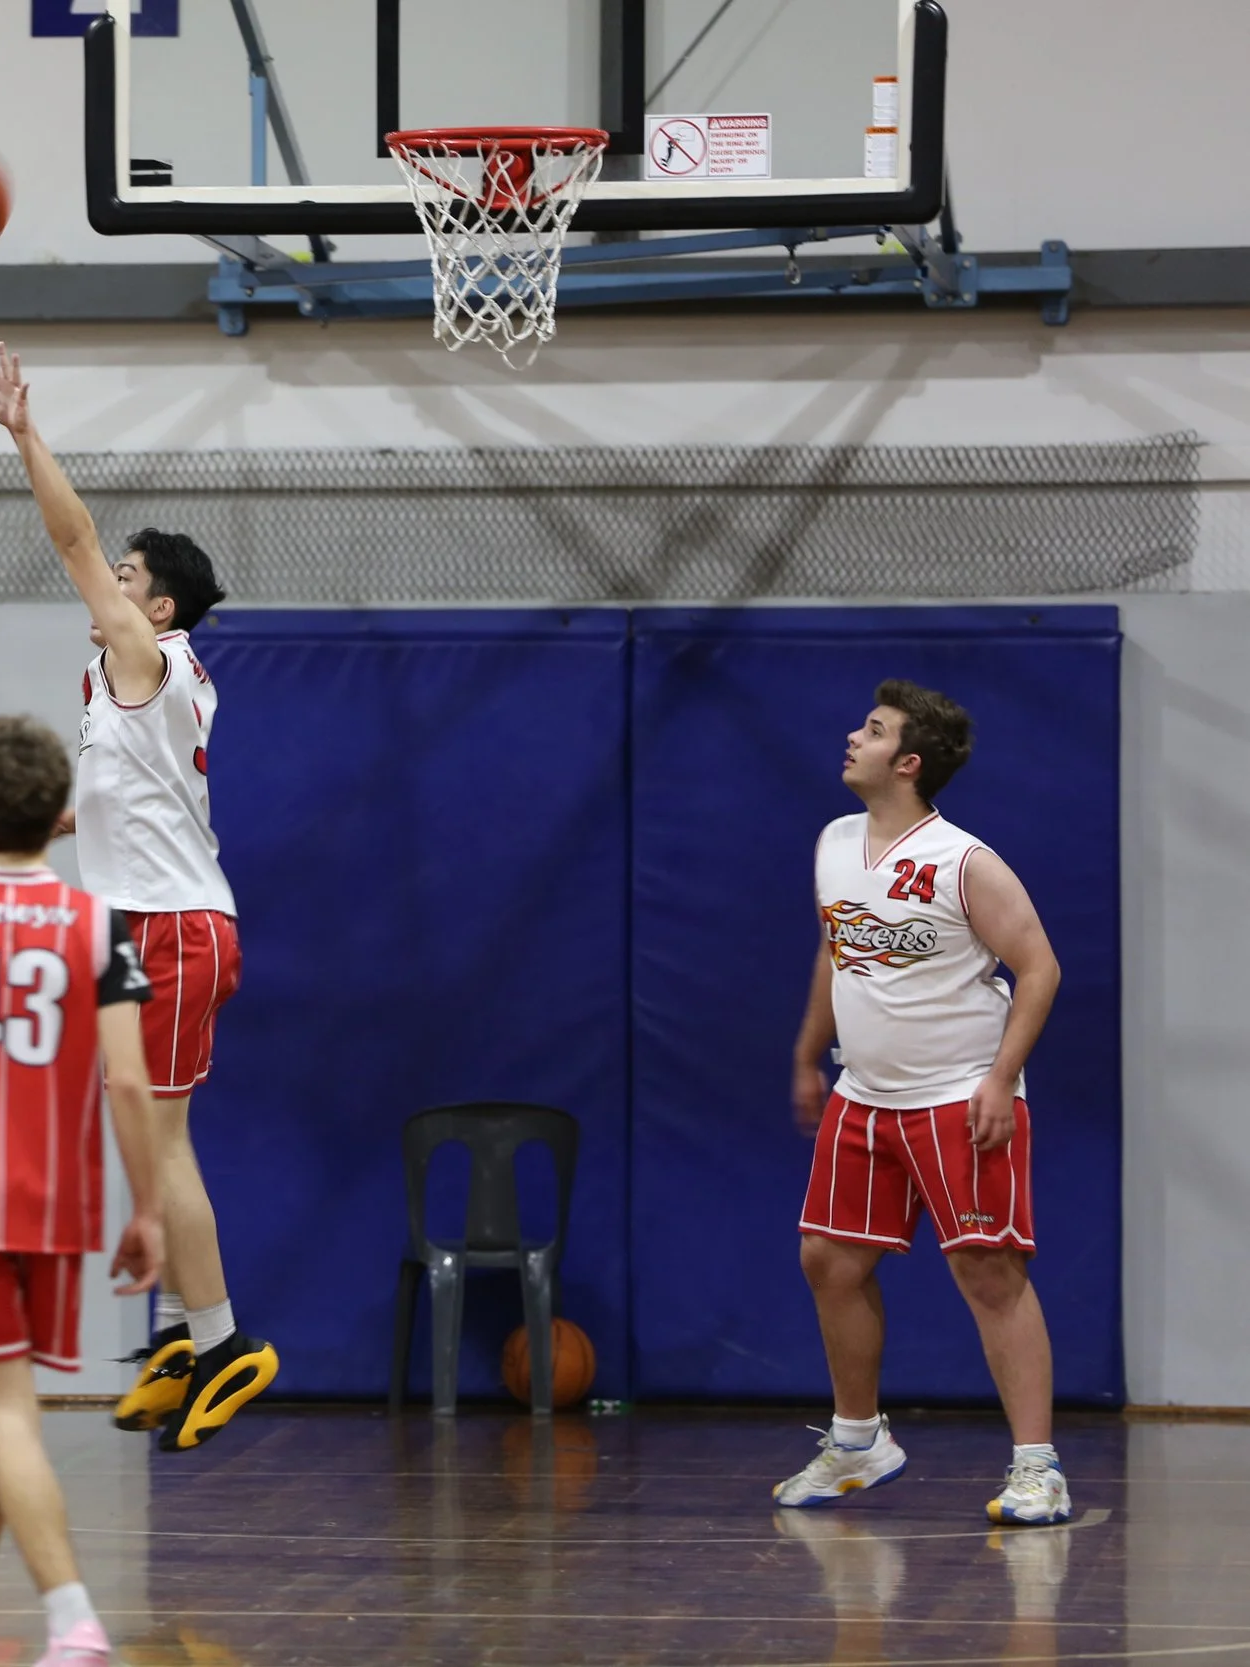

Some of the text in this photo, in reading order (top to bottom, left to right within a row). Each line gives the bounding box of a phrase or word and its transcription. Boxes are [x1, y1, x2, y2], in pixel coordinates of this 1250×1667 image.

[720, 119, 767, 128] WARNING
[887, 859, 938, 904] 24
[825, 921, 938, 952] LAZERS
